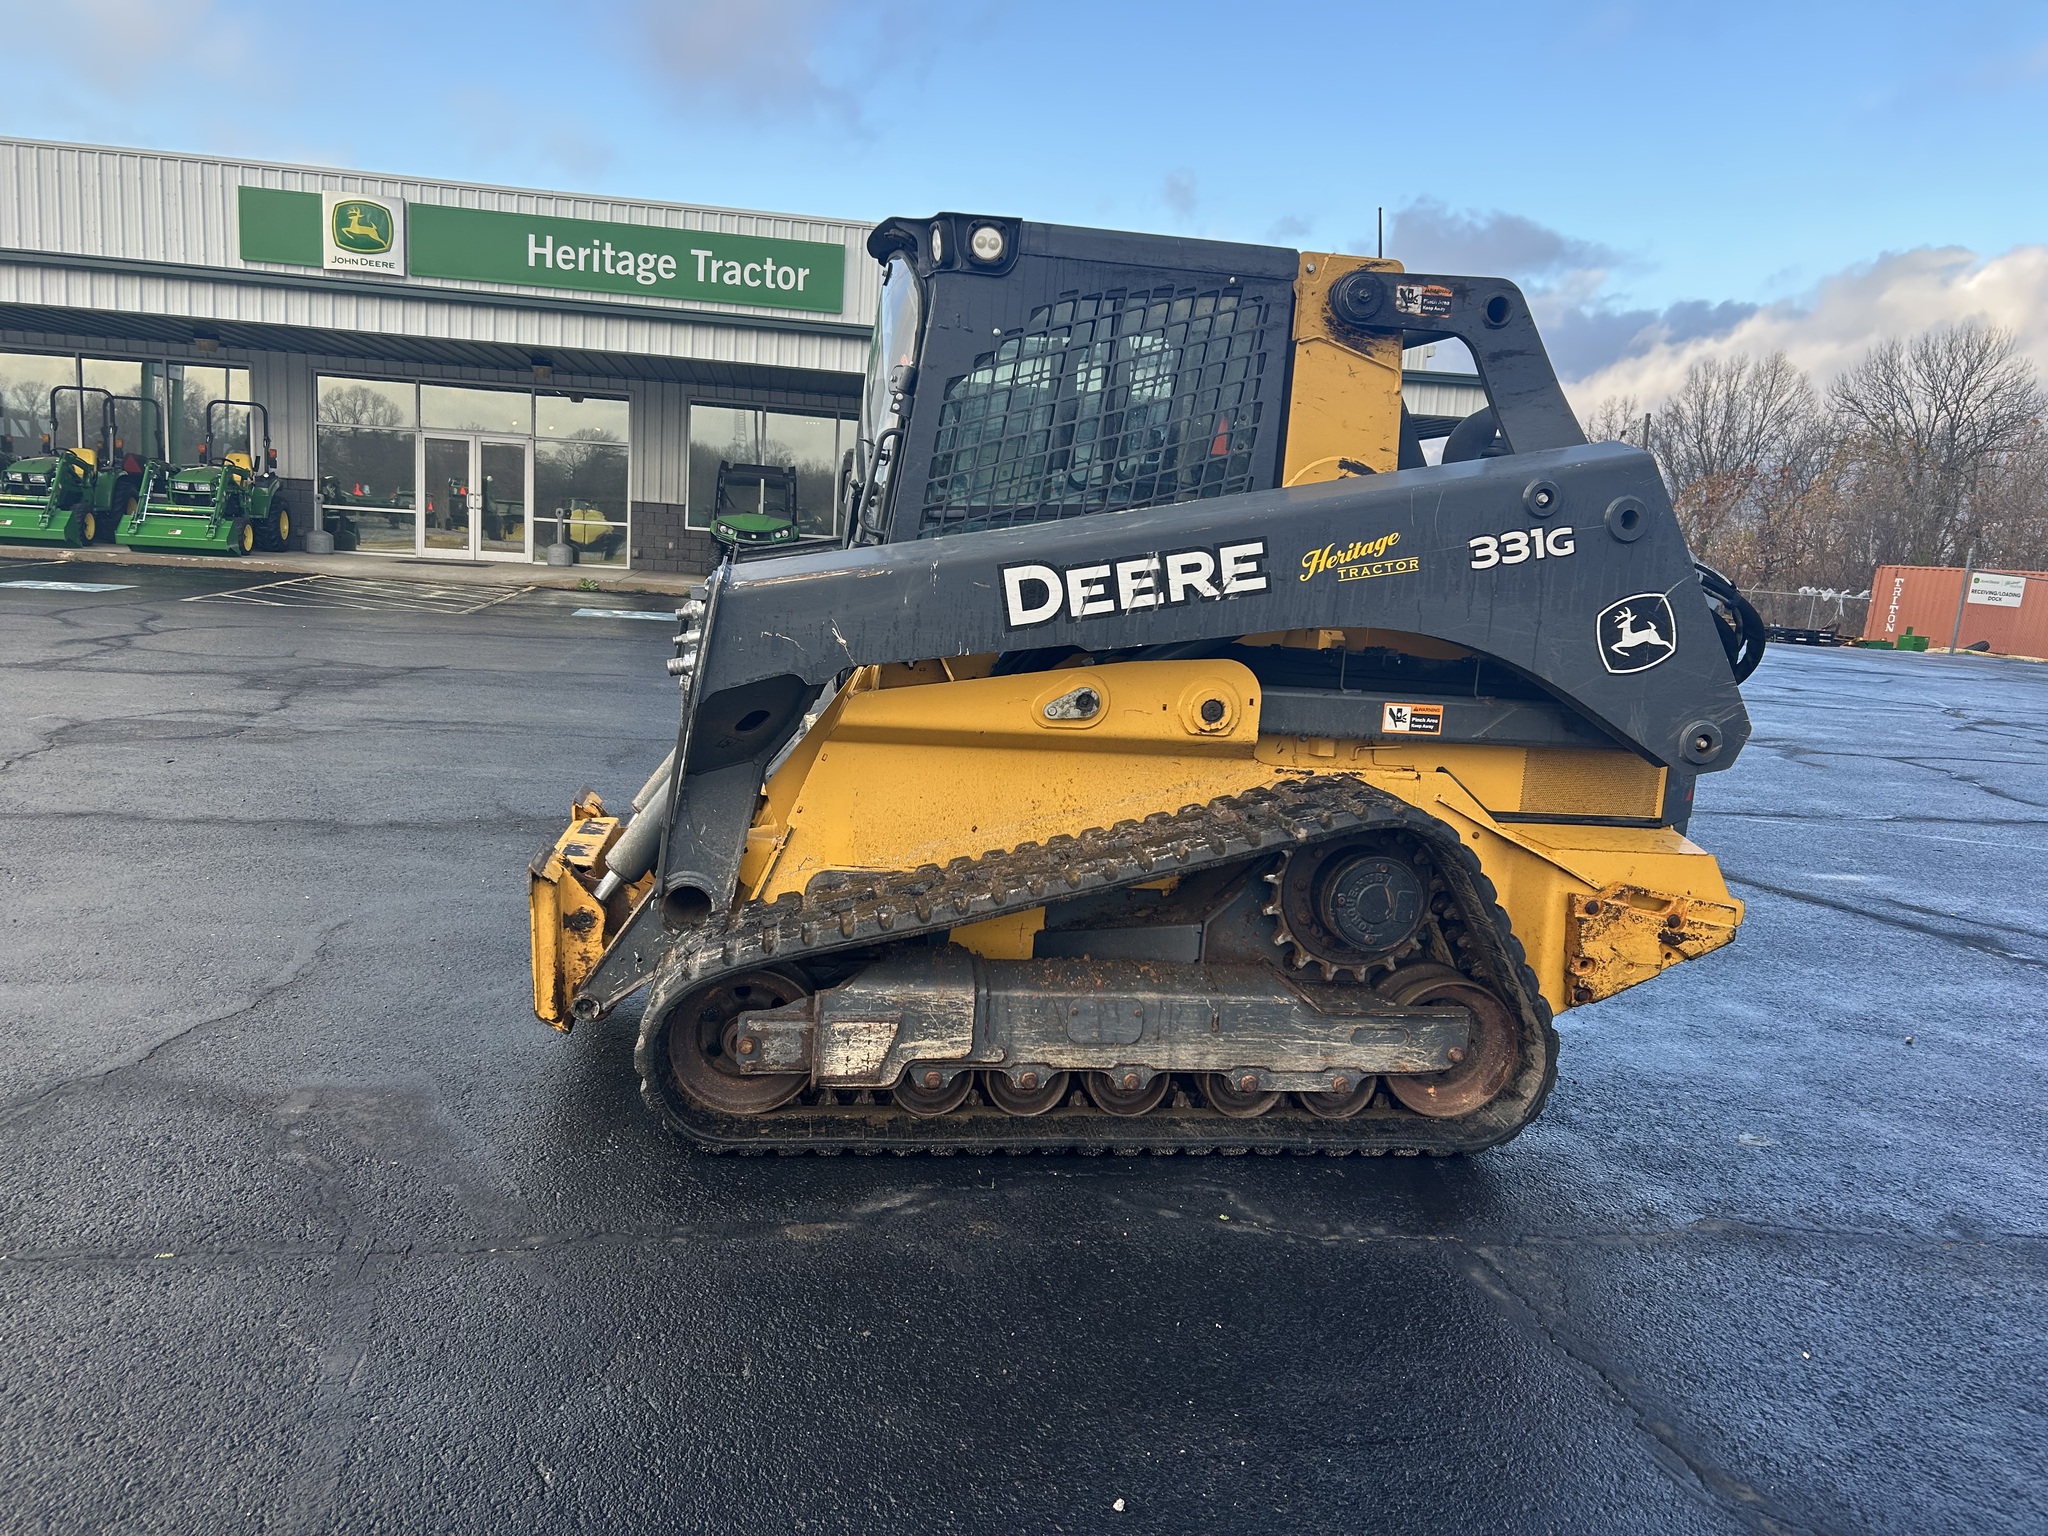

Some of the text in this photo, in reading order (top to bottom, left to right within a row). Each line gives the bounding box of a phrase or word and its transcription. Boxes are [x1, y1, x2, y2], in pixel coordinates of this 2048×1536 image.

[331, 255, 396, 271] JOHN DEERE
[527, 233, 810, 291] Heritage Tractor
[1299, 532, 1401, 582] Heritage
[1338, 559, 1419, 579] TRACTOR
[1468, 527, 1576, 570] 331G
[1002, 541, 1268, 627] DEERE
[1885, 577, 1905, 633] TRITON
[1971, 588, 2022, 598] RECEIVING/LOADING
[1987, 595, 2003, 604] DOCK
